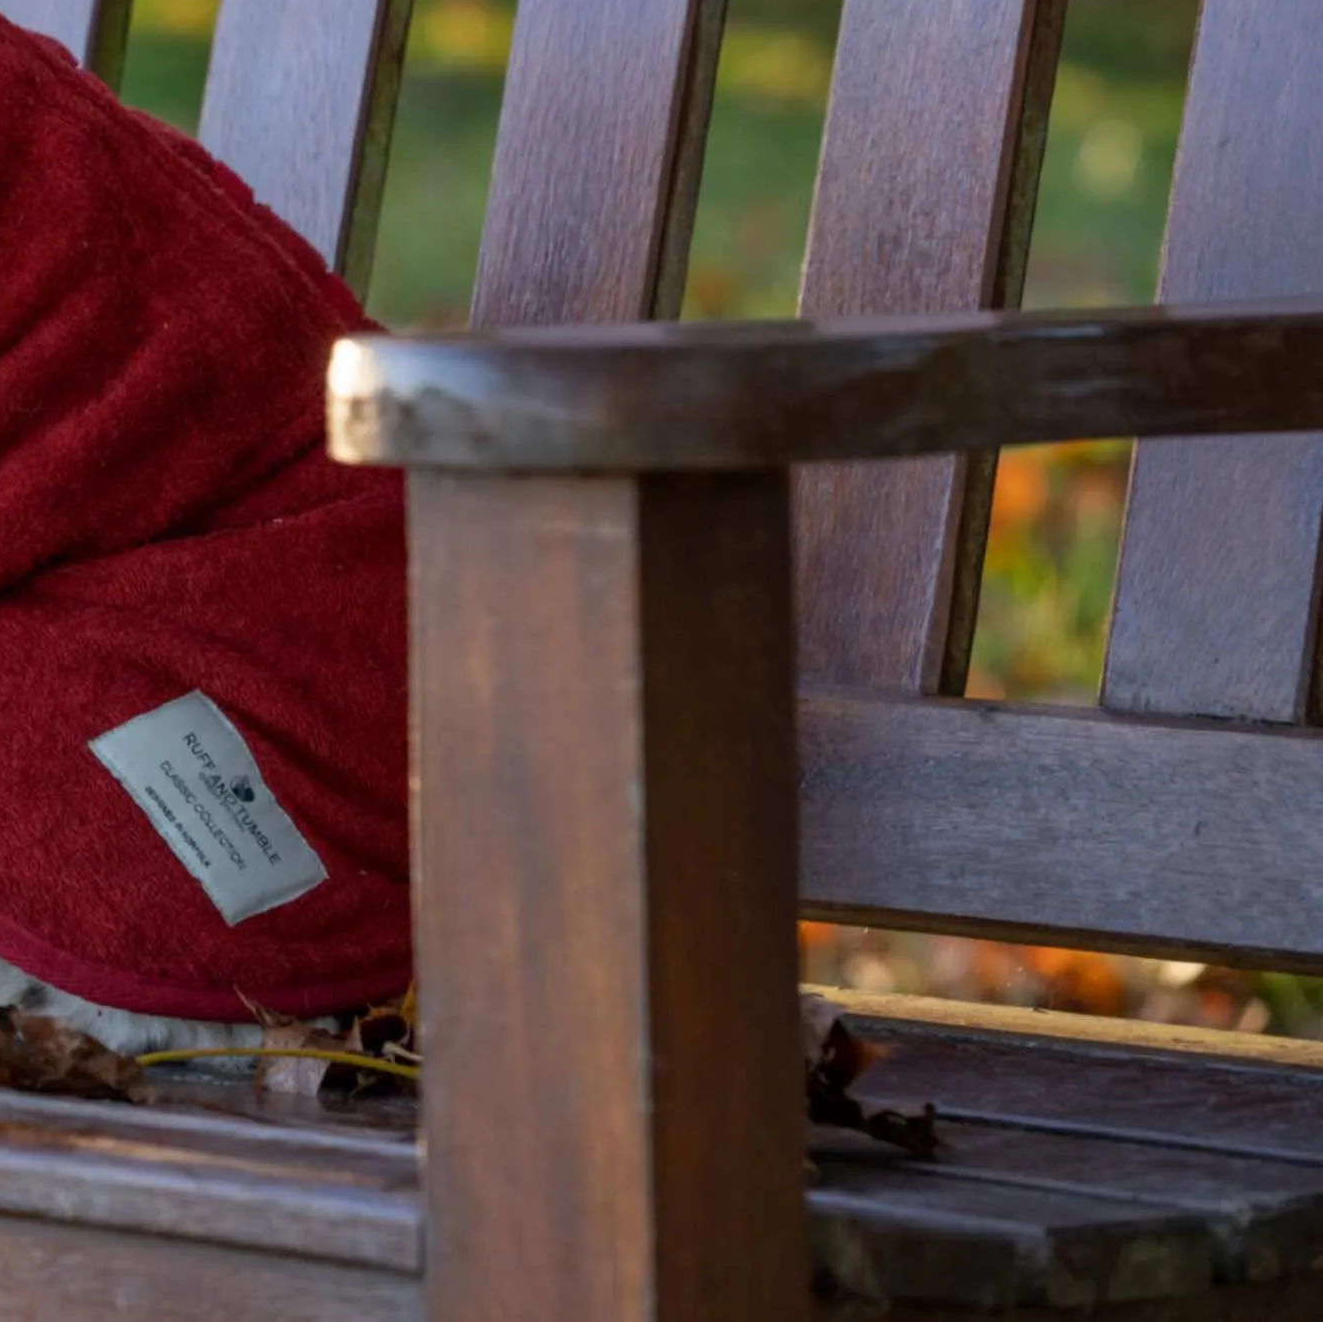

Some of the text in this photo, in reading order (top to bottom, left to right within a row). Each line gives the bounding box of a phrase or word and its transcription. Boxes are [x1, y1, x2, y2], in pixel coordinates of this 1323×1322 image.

[160, 760, 247, 870] CLASSIC COLLECTION
[183, 732, 282, 866] RUFF AND TUMBLE
